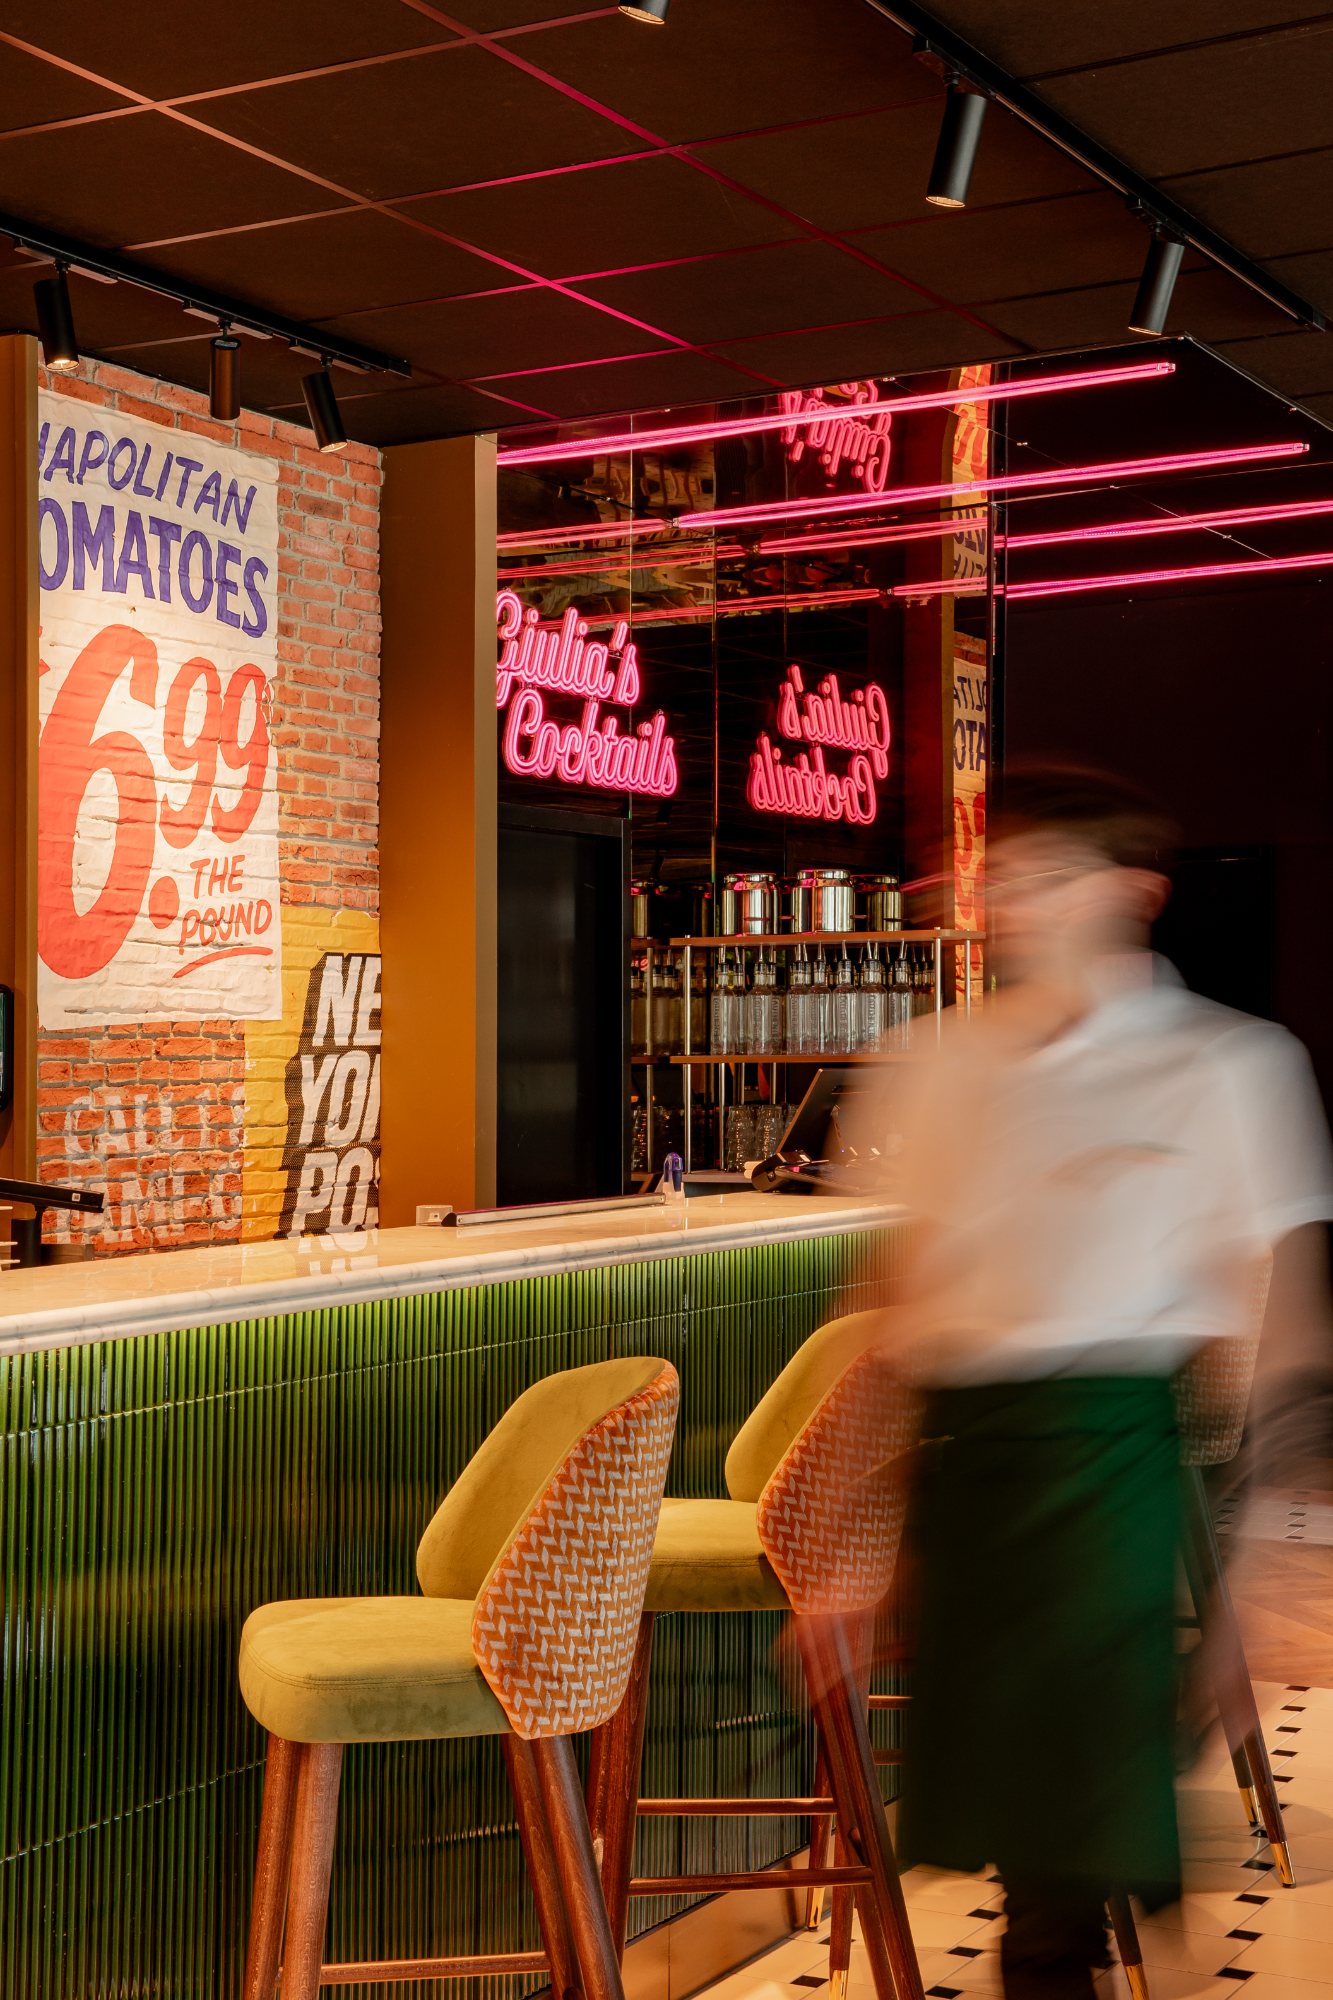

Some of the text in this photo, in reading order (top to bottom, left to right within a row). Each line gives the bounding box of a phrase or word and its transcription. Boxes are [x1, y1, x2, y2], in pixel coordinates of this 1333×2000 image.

[38, 497, 269, 638] OMATOES
[496, 588, 641, 707] Giulia's
[503, 686, 678, 797] Cocktails
[190, 855, 246, 898] THE
[178, 899, 273, 955] POUND
[287, 1147, 379, 1237] PO
